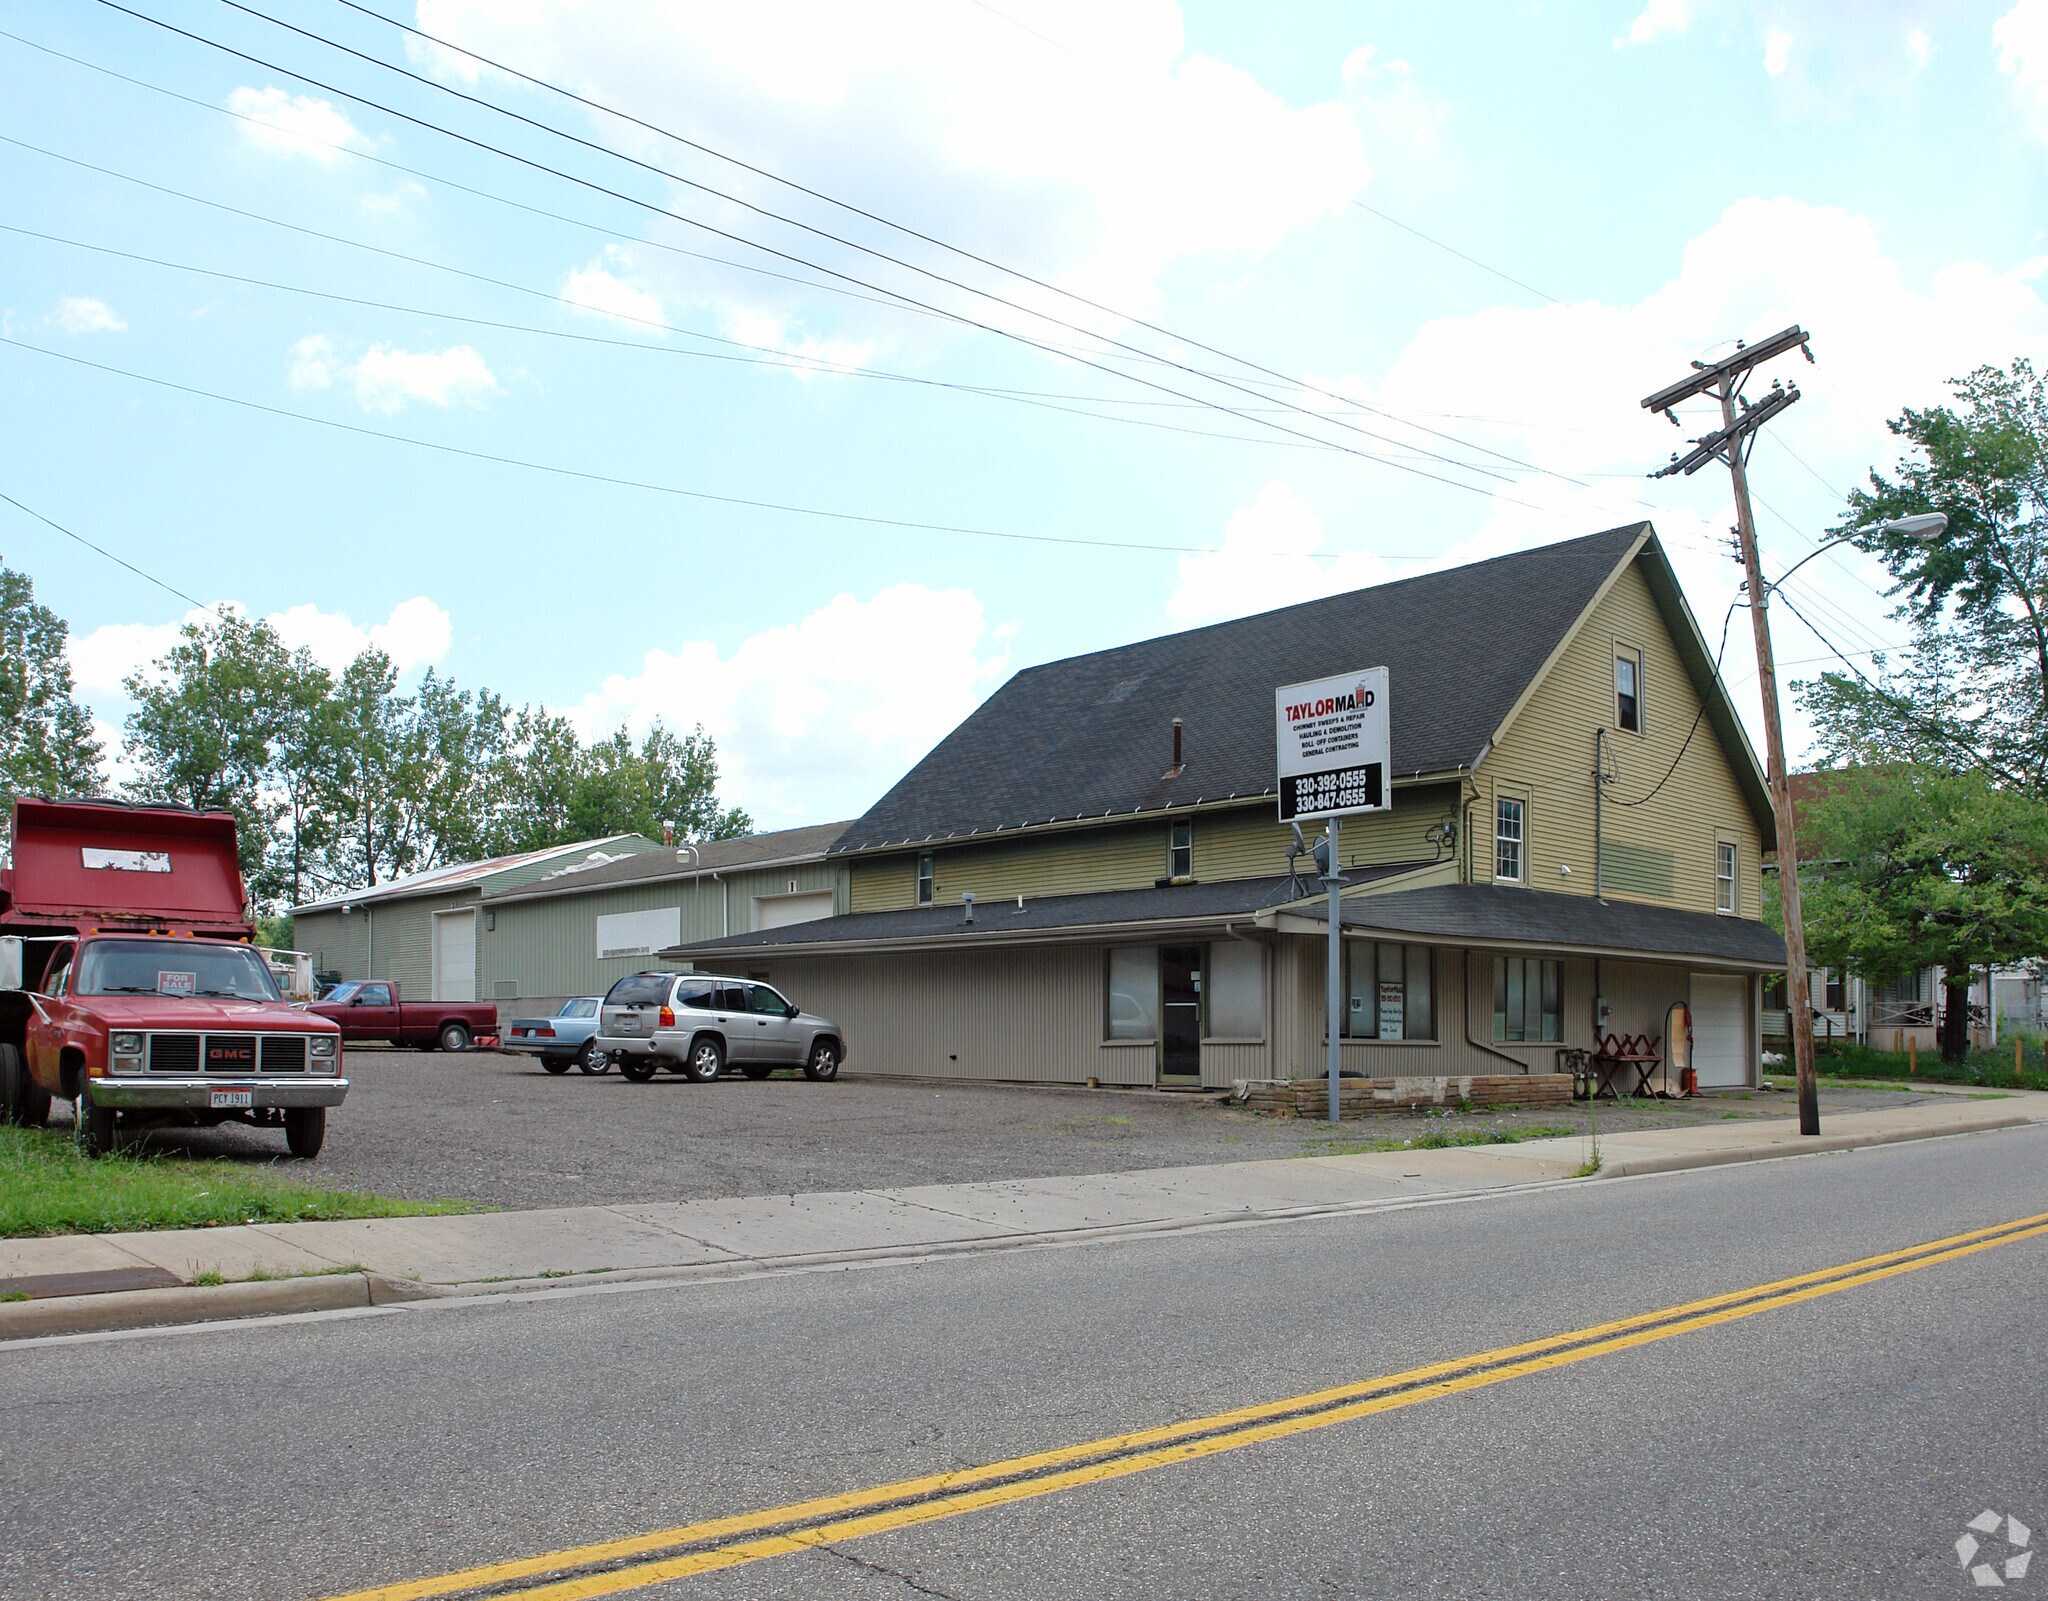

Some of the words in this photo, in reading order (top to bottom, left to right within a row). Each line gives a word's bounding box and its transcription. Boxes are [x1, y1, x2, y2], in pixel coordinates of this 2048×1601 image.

[1293, 722, 1316, 731] CHIMNEY
[1317, 717, 1339, 728] SWEEPS
[1346, 713, 1365, 721] REPAIR
[1299, 729, 1323, 740] HAULING
[1329, 722, 1362, 735] DEMOLITION
[1301, 741, 1315, 749] ROLL
[1316, 738, 1327, 746] OFF
[1327, 732, 1359, 744] CONTAINERS
[1302, 748, 1325, 758] GENERAL
[1325, 742, 1359, 753] CONTRACTING
[1295, 769, 1366, 795] 330-392-0555
[1296, 787, 1366, 812] 330-847-0555
[162, 981, 192, 989] SALE
[166, 974, 189, 982] FOR
[210, 1050, 251, 1059] GMC
[213, 1093, 228, 1104] PCY
[230, 1093, 248, 1104] 1911
